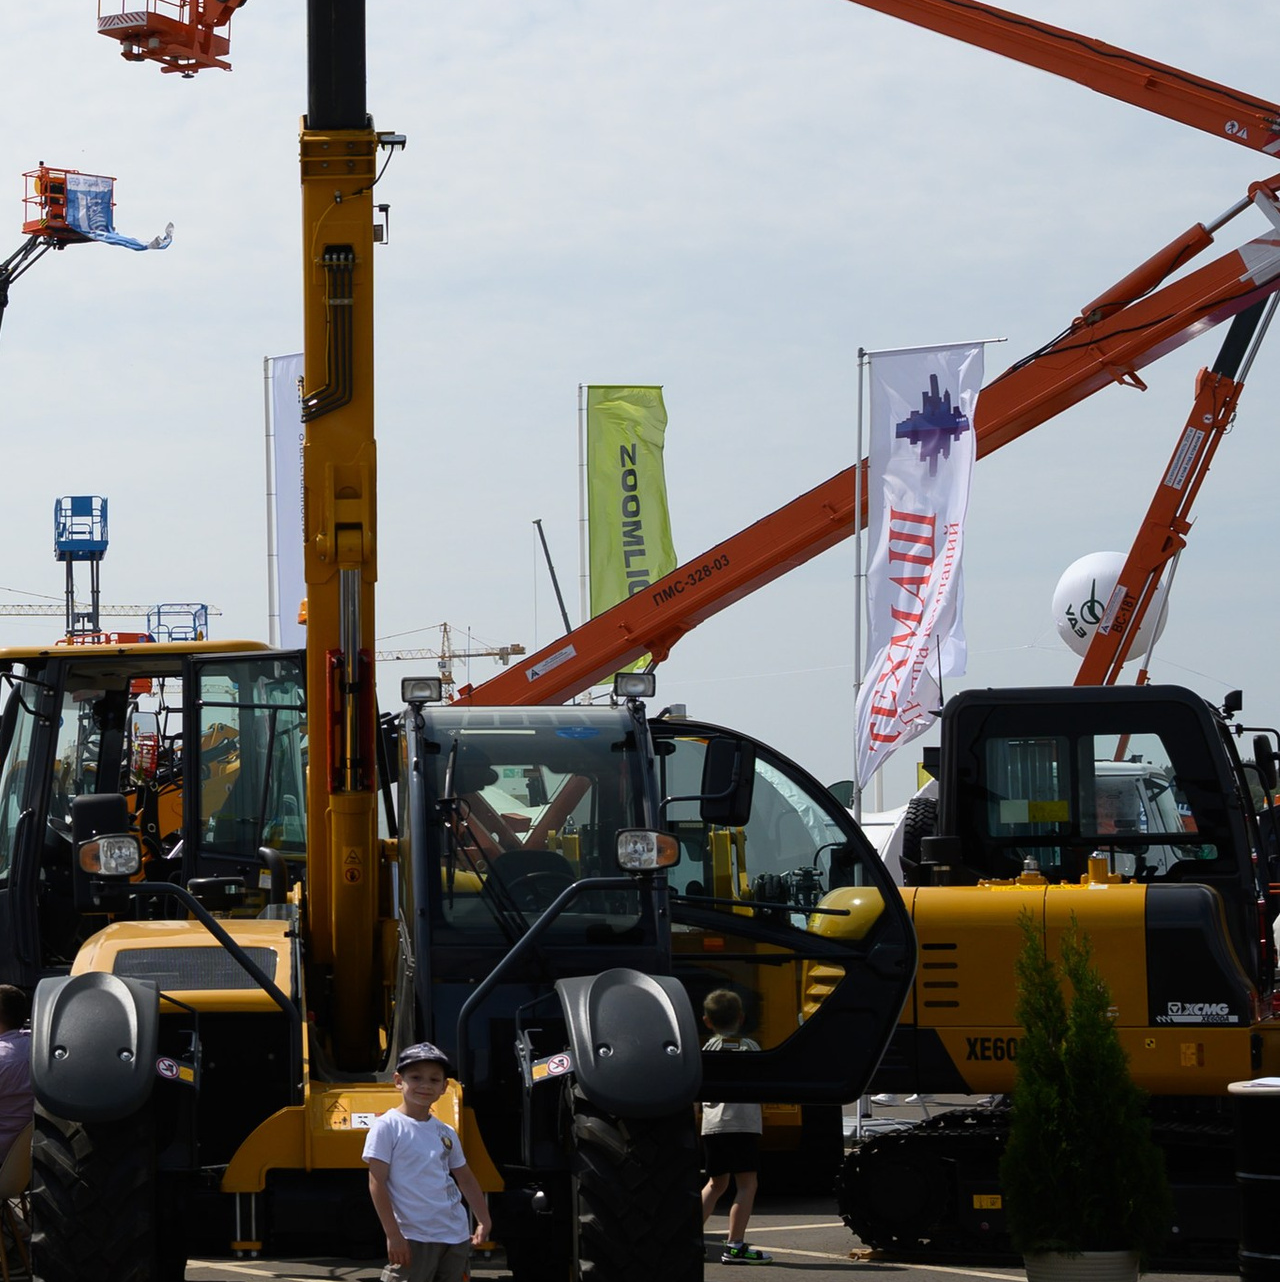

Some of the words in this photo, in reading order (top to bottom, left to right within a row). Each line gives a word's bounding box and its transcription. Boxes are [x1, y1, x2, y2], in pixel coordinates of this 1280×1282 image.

[652, 554, 731, 607] ПМС-328-03
[868, 506, 937, 753] ТЕХМАШ
[1065, 603, 1087, 638] УАЗ
[1182, 1003, 1230, 1016] XCMG
